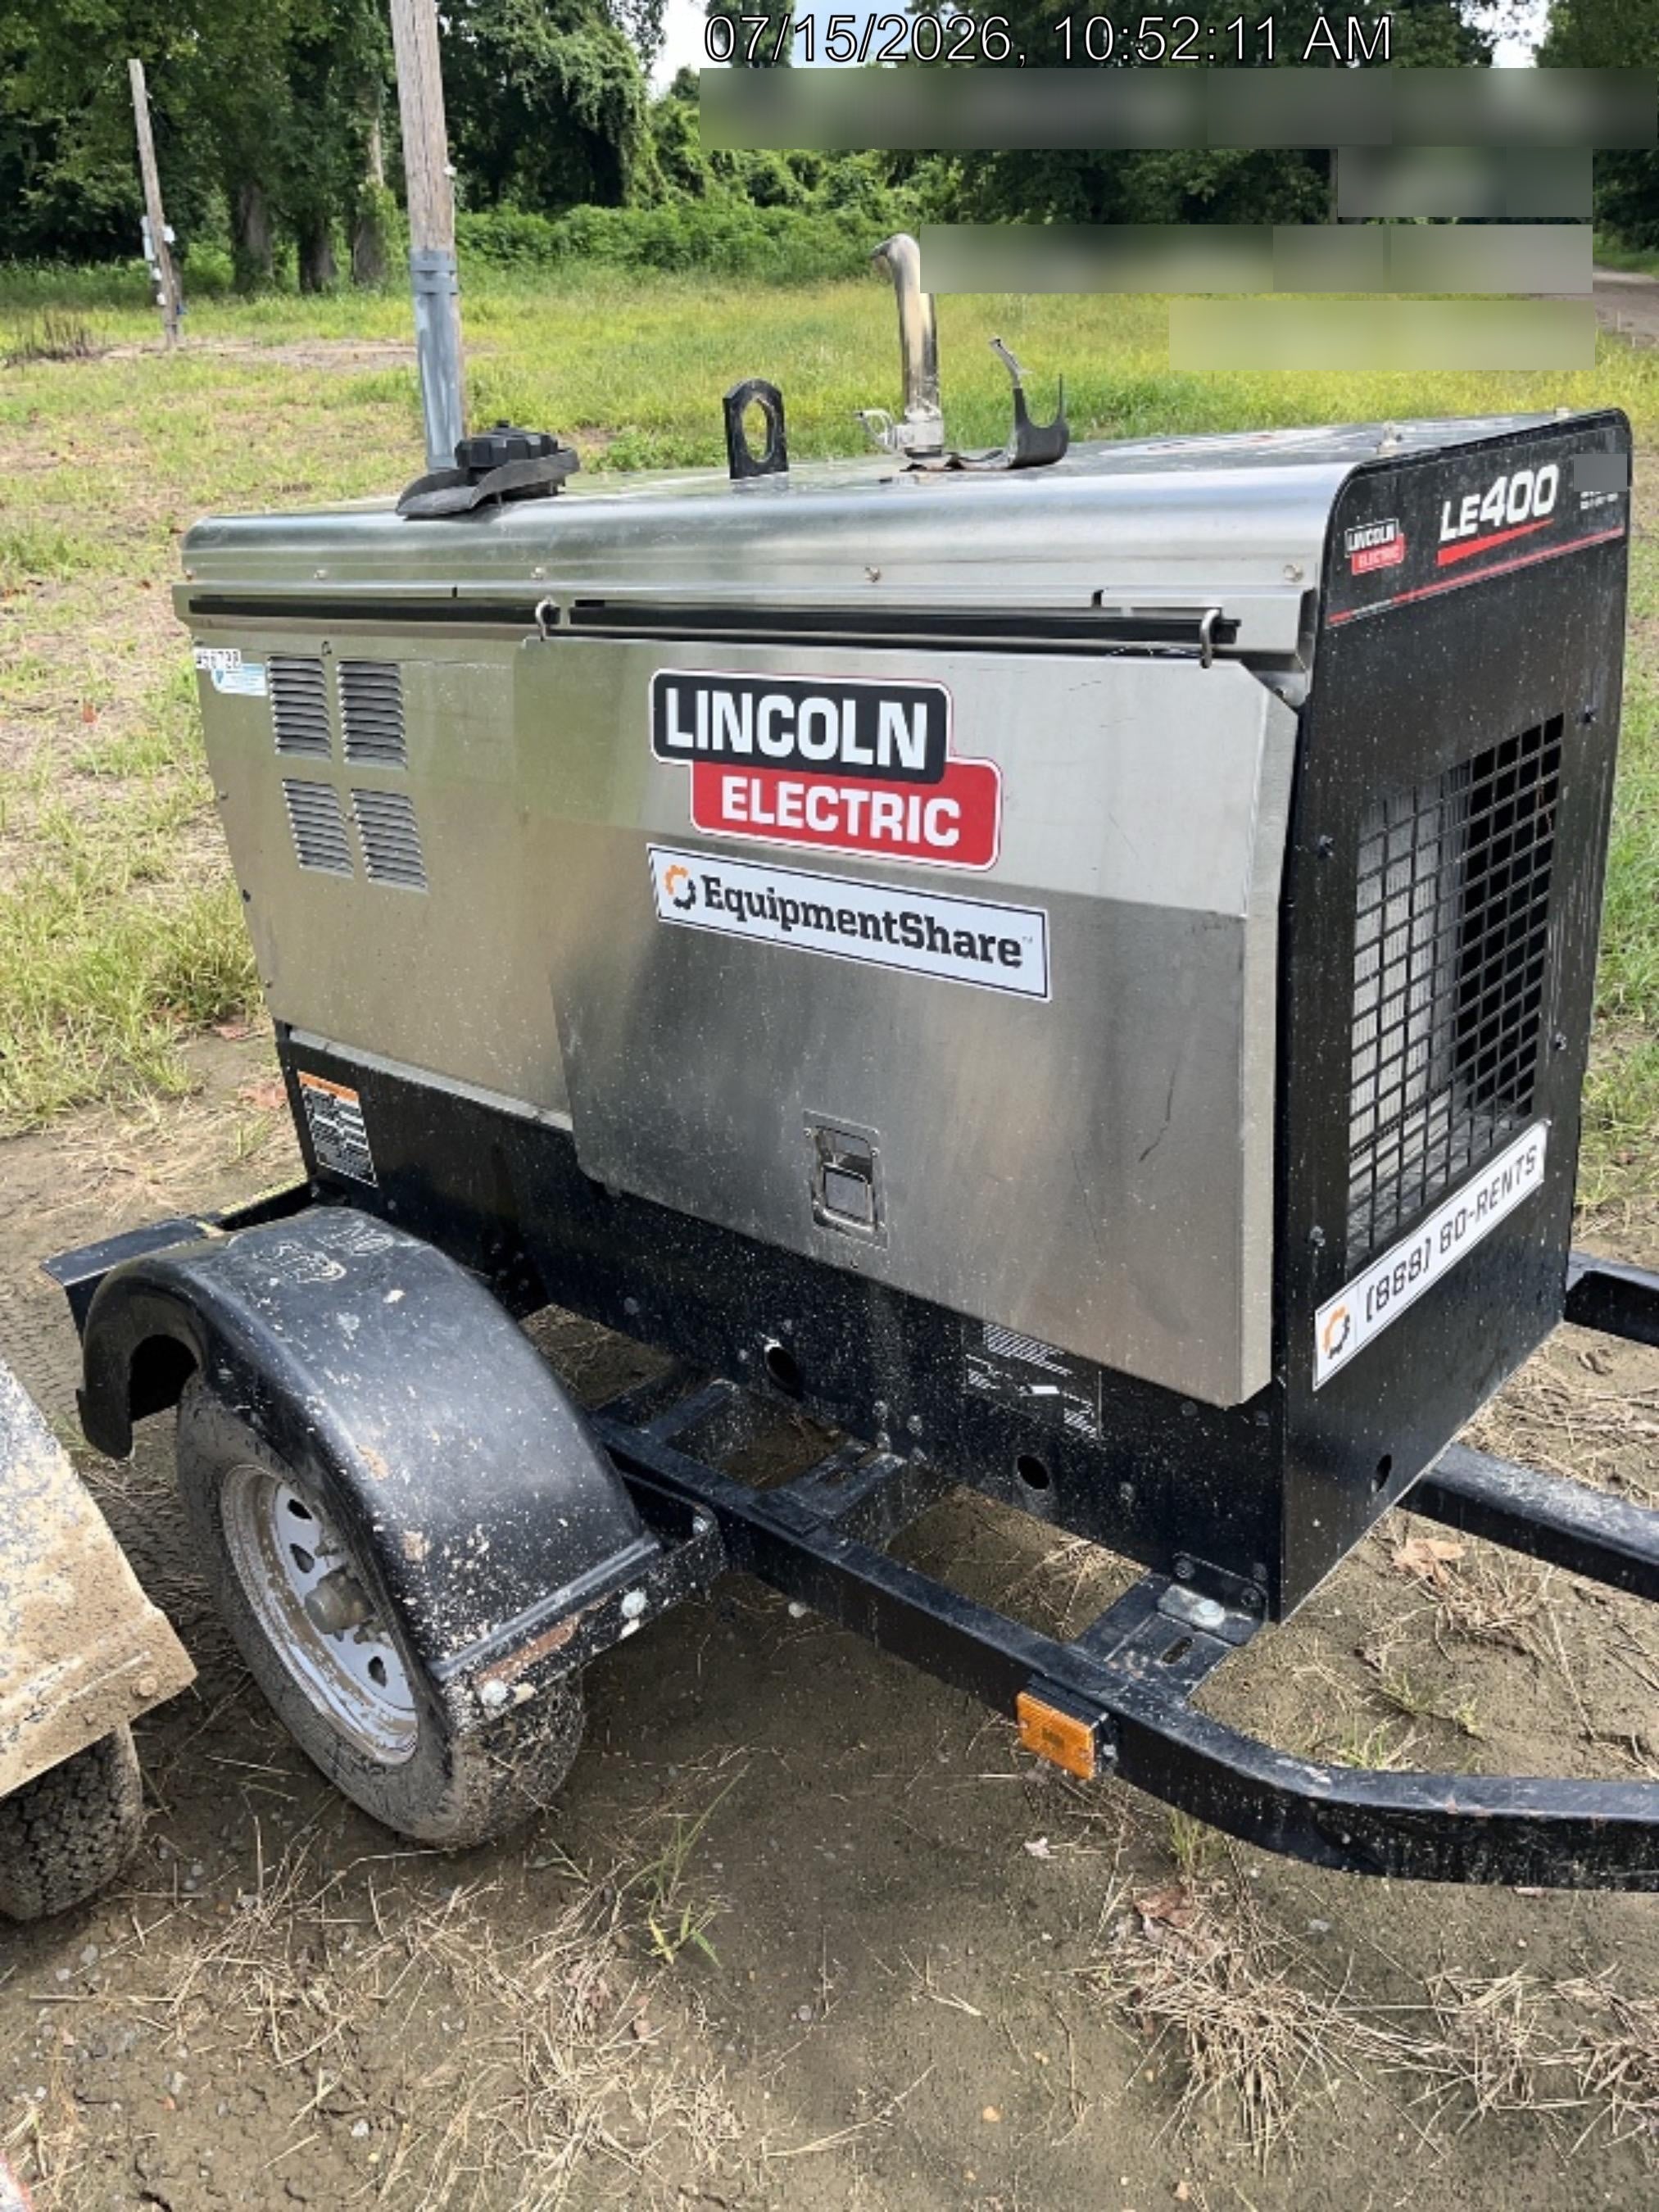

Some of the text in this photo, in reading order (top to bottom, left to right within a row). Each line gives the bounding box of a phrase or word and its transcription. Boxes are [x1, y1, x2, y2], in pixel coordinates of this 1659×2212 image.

[1439, 463, 1560, 543] LE400
[664, 687, 928, 771] LINCOLN
[721, 775, 961, 848] ELECTRIC
[700, 874, 1022, 969] EquipmentShare
[1365, 1144, 1538, 1322] (888) 80-RENTS
